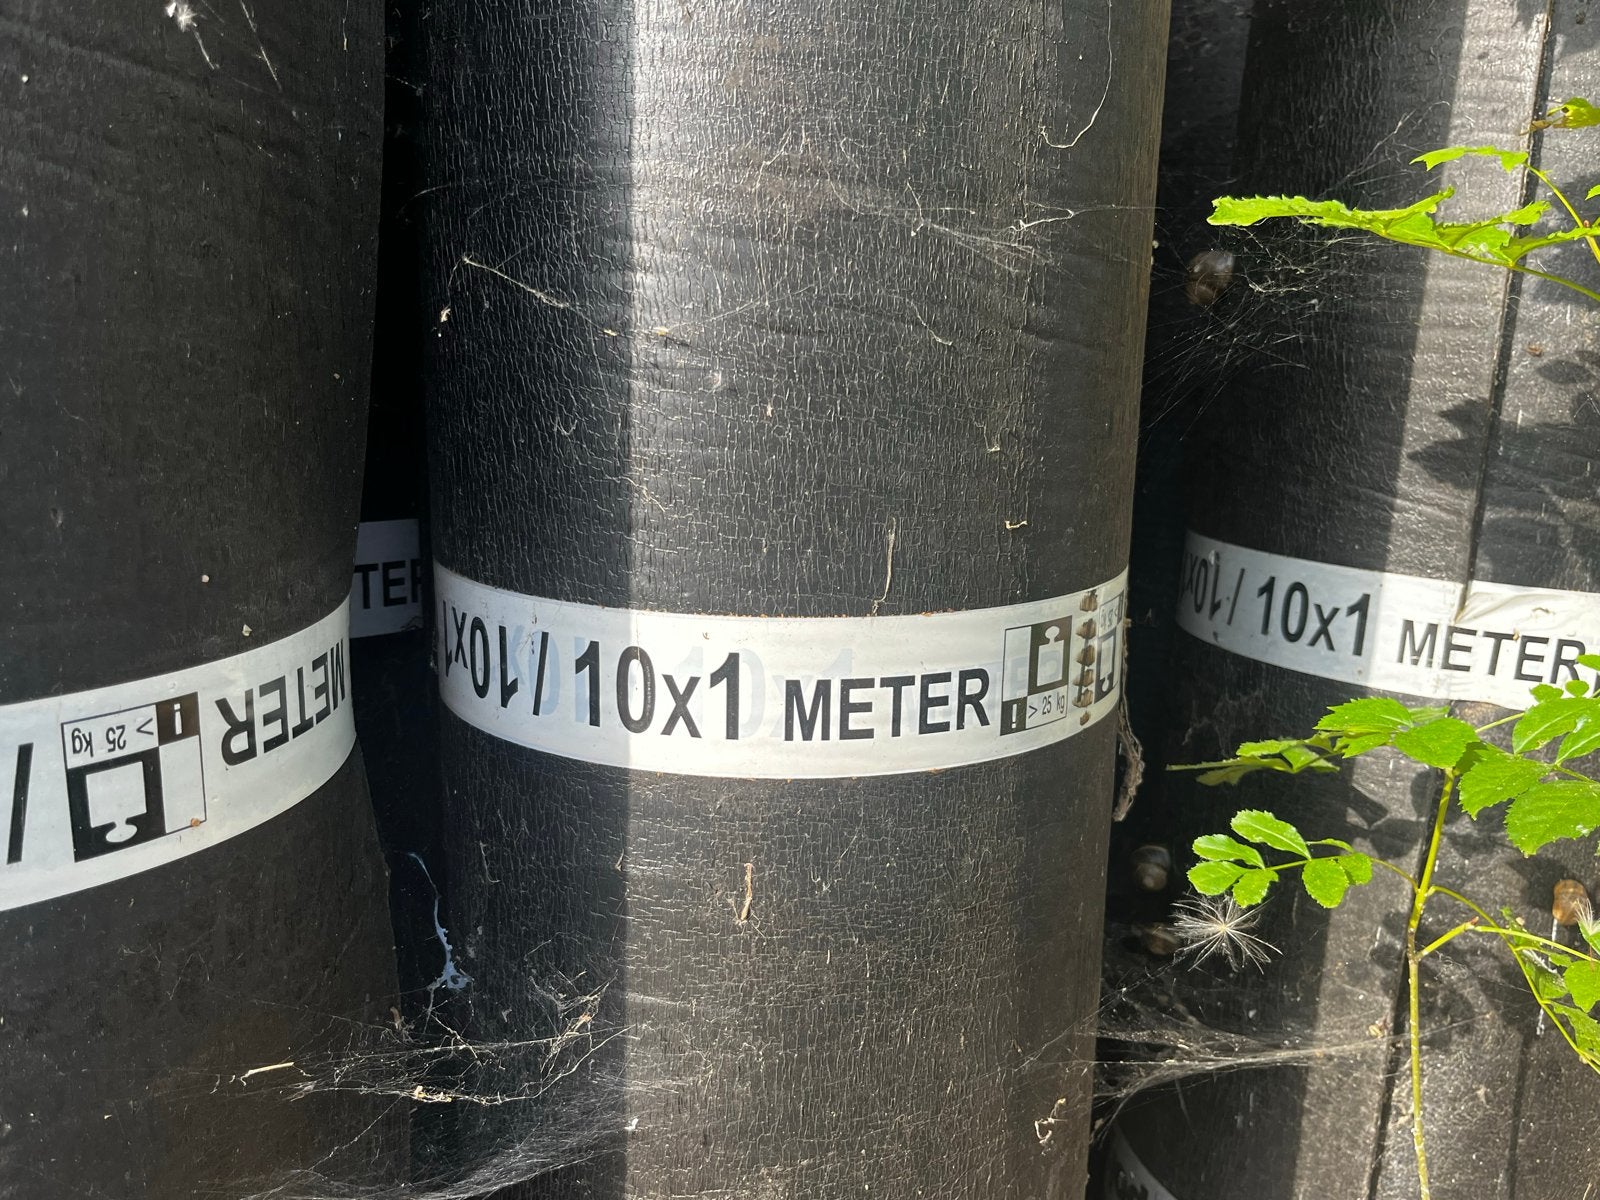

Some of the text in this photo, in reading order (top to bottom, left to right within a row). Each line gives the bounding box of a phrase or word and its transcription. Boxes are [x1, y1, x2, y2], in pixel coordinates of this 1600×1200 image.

[443, 599, 519, 709] 10x1
[1257, 576, 1371, 657] 10x1
[1397, 619, 1586, 685] METER
[106, 724, 127, 753] 25
[214, 638, 346, 766] METER
[575, 640, 740, 741] 10x1
[784, 668, 990, 741] METER
[1041, 694, 1052, 716] 25
[1056, 692, 1065, 714] kg
[71, 727, 94, 758] kg
